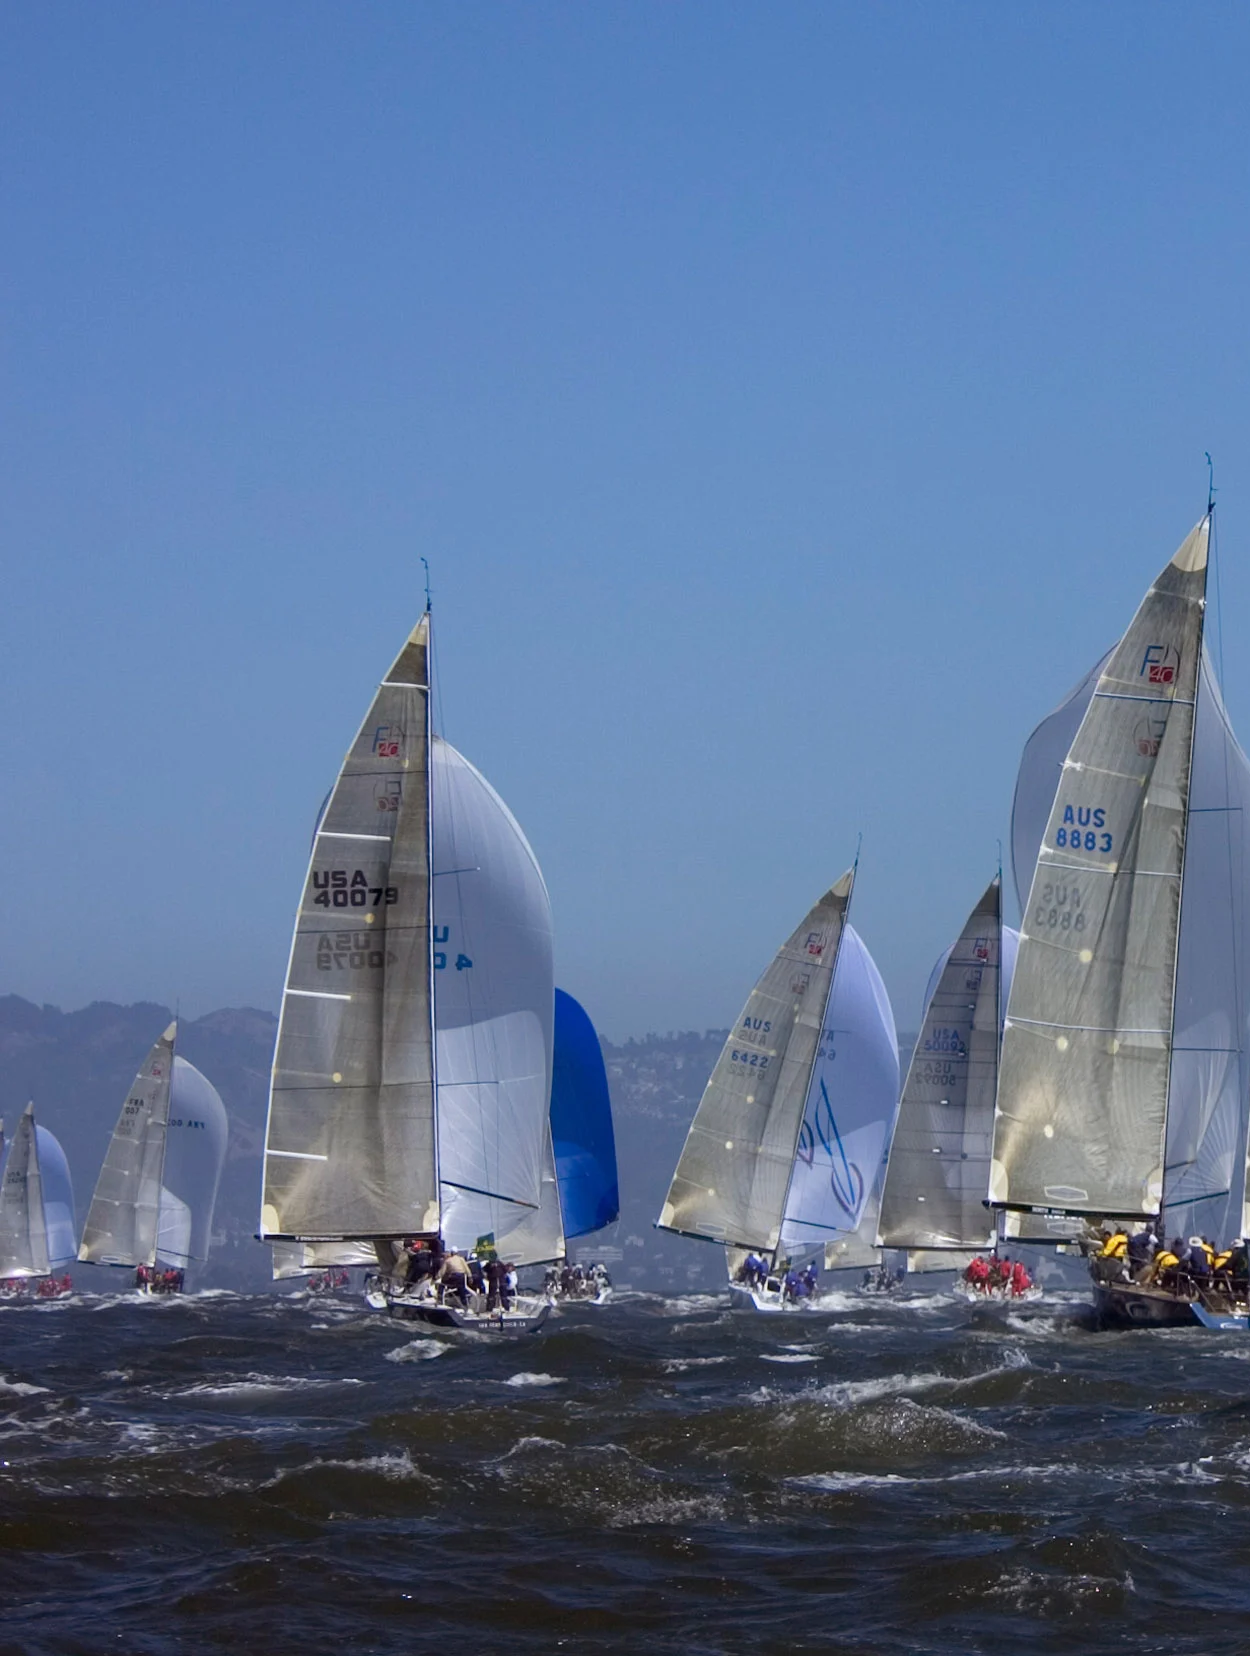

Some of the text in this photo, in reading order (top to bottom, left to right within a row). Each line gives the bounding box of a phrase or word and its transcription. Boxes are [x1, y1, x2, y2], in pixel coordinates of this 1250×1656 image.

[1062, 804, 1106, 828] AUS
[1056, 827, 1113, 853] 8883
[313, 869, 368, 889] USA
[313, 886, 399, 908] 40079
[743, 1016, 771, 1033] AUS
[932, 1027, 960, 1040] USA
[731, 1050, 769, 1069] 6422
